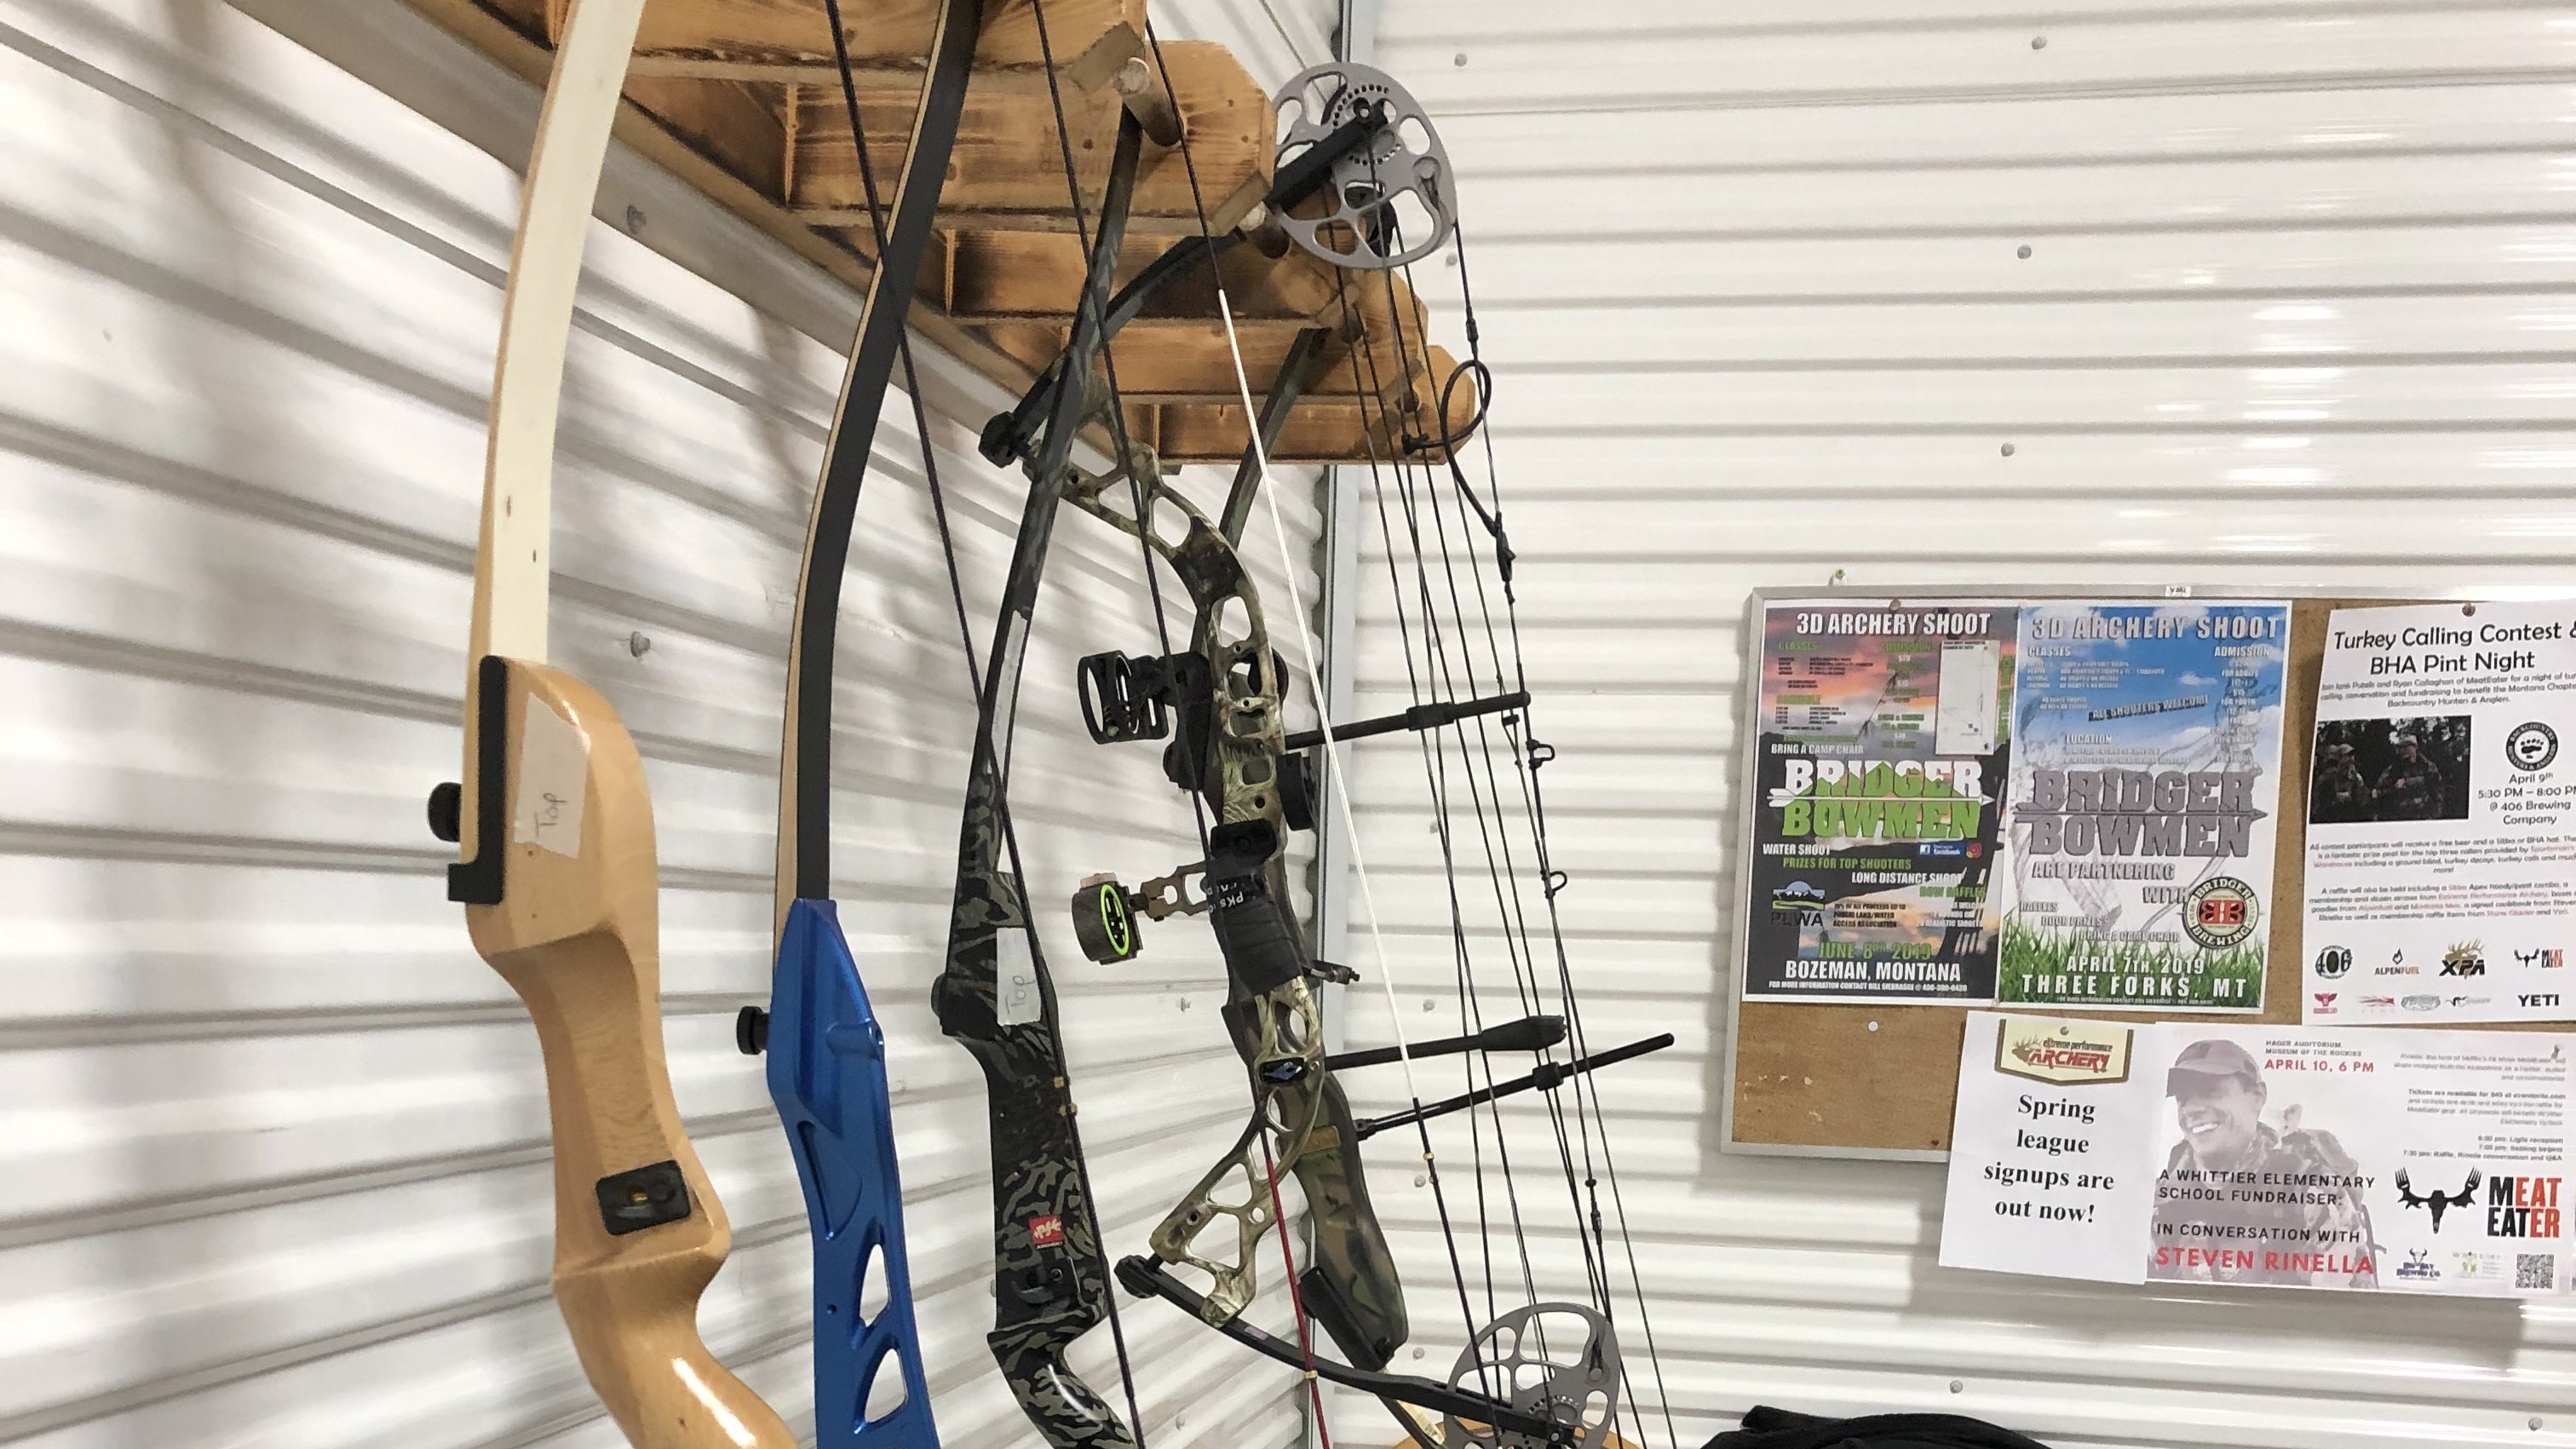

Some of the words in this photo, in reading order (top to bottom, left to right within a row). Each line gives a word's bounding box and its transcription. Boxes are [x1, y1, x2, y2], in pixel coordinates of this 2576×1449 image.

[1797, 612, 1823, 635] 3D
[1827, 612, 1918, 635] ARCHERY
[1923, 612, 1991, 635] SHOOT
[2033, 615, 2067, 639] 3D
[2073, 615, 2187, 639] ARCHERY
[2197, 615, 2280, 640] SHOOT
[2333, 630, 2396, 651] Turkey
[2402, 626, 2473, 647] Calling
[2480, 622, 2562, 643] Contest
[2028, 647, 2072, 657] CLASSES
[2214, 646, 2270, 657] ADMISSION
[2370, 655, 2417, 676] BHA
[2424, 653, 2468, 674] Pint
[2475, 650, 2536, 674] Night
[2393, 680, 2412, 688] Ryan
[2466, 676, 2508, 684] MeatEater
[2532, 673, 2552, 682] night
[2408, 687, 2451, 696] fundraising
[2463, 686, 2491, 694] benefit
[2508, 684, 2545, 693] Montana
[2388, 699, 2436, 707] Backcountry
[2438, 697, 2470, 705] Hunters
[2090, 708, 2107, 722] ALL
[2107, 702, 2162, 720] SHOOTERS
[2065, 734, 2113, 745] LOCATION
[1771, 744, 1798, 755] BRING
[1800, 744, 1807, 755] A
[1808, 745, 1836, 755] CAMP
[1837, 745, 1865, 756] CHAIR
[1785, 760, 1982, 798] BRIDGER
[2509, 773, 2536, 785] April
[2539, 772, 2554, 783] 9th
[2033, 771, 2256, 813] BRIDGER
[2478, 789, 2502, 799] 5:30
[2504, 787, 2523, 797] PM
[2537, 786, 2562, 796] 8:00
[536, 792, 569, 837] Top
[2489, 801, 2498, 811] @
[2501, 802, 2523, 812] 406
[2526, 800, 2572, 811] Brewing
[1781, 799, 1982, 839] BOWMEN
[2503, 814, 2557, 825] Company
[2029, 815, 2252, 858] BOWMEN
[1762, 843, 1796, 855] WATER
[1797, 844, 1831, 856] SHOOT
[1783, 858, 1816, 869] PRIZES
[1818, 858, 1837, 869] FOR
[1839, 859, 1859, 869] TOP
[1860, 859, 1912, 871] SHOOTERS
[2032, 862, 2067, 879] ARE
[2068, 862, 2176, 881] PARTNERING
[1851, 871, 1877, 883] LONG
[1879, 872, 1929, 884] DISTANCE
[1929, 873, 1964, 884] SHOOT
[2142, 886, 2190, 905] WITH
[2194, 878, 2253, 899] BRIDGER
[1771, 912, 1824, 927] PLWA
[2079, 929, 2110, 941] BRING
[2148, 932, 2181, 943] CHAIR
[2192, 926, 2250, 946] BREWING
[1818, 941, 1854, 959] JUNE
[1863, 941, 1887, 959] 8TH
[1891, 943, 1932, 960] 2019
[1785, 960, 1871, 981] BOZEMAN,
[1876, 962, 1962, 982] MONTANA
[2067, 956, 2116, 973] APRIL
[2124, 957, 2153, 975] 7TH,
[2160, 957, 2205, 975] 2019
[2314, 949, 2353, 974] 406
[2374, 965, 2420, 975] ALPENFUEL
[2439, 959, 2486, 977] XPA
[1006, 975, 1036, 1015] Top
[2022, 974, 2097, 995] THREE
[2110, 975, 2200, 998] FORKS,
[2213, 978, 2247, 998] MT
[2518, 994, 2560, 1007] YETI
[2070, 1040, 2113, 1053] performance
[2029, 1049, 2111, 1073] ARCHERY
[2264, 1059, 2307, 1071] APRIL
[2312, 1061, 2333, 1072] 10,
[2338, 1061, 2348, 1072] 6
[2353, 1061, 2375, 1073] PM
[2017, 1094, 2096, 1124] Spring
[2016, 1129, 2090, 1156] league
[1984, 1161, 2069, 1190] signups
[2078, 1174, 2115, 1190] are
[2159, 1169, 2170, 1181] A
[2176, 1169, 2257, 1184] WHITTIER
[2263, 1172, 2376, 1188] ELEMENTARY
[2159, 1187, 2224, 1201] SCHOOL
[2231, 1189, 2343, 1206] FUNDRAISER:
[2489, 1176, 2562, 1207] MEAT
[1995, 1199, 2033, 1217] out
[2039, 1204, 2096, 1223] now!
[2487, 1206, 2561, 1238] EATER
[2157, 1223, 2173, 1235] IN
[2180, 1223, 2310, 1241] CONVERSATION
[2317, 1229, 2360, 1244] WITH
[2155, 1246, 2254, 1269] STEVEN
[2264, 1251, 2374, 1274] RINELLA
